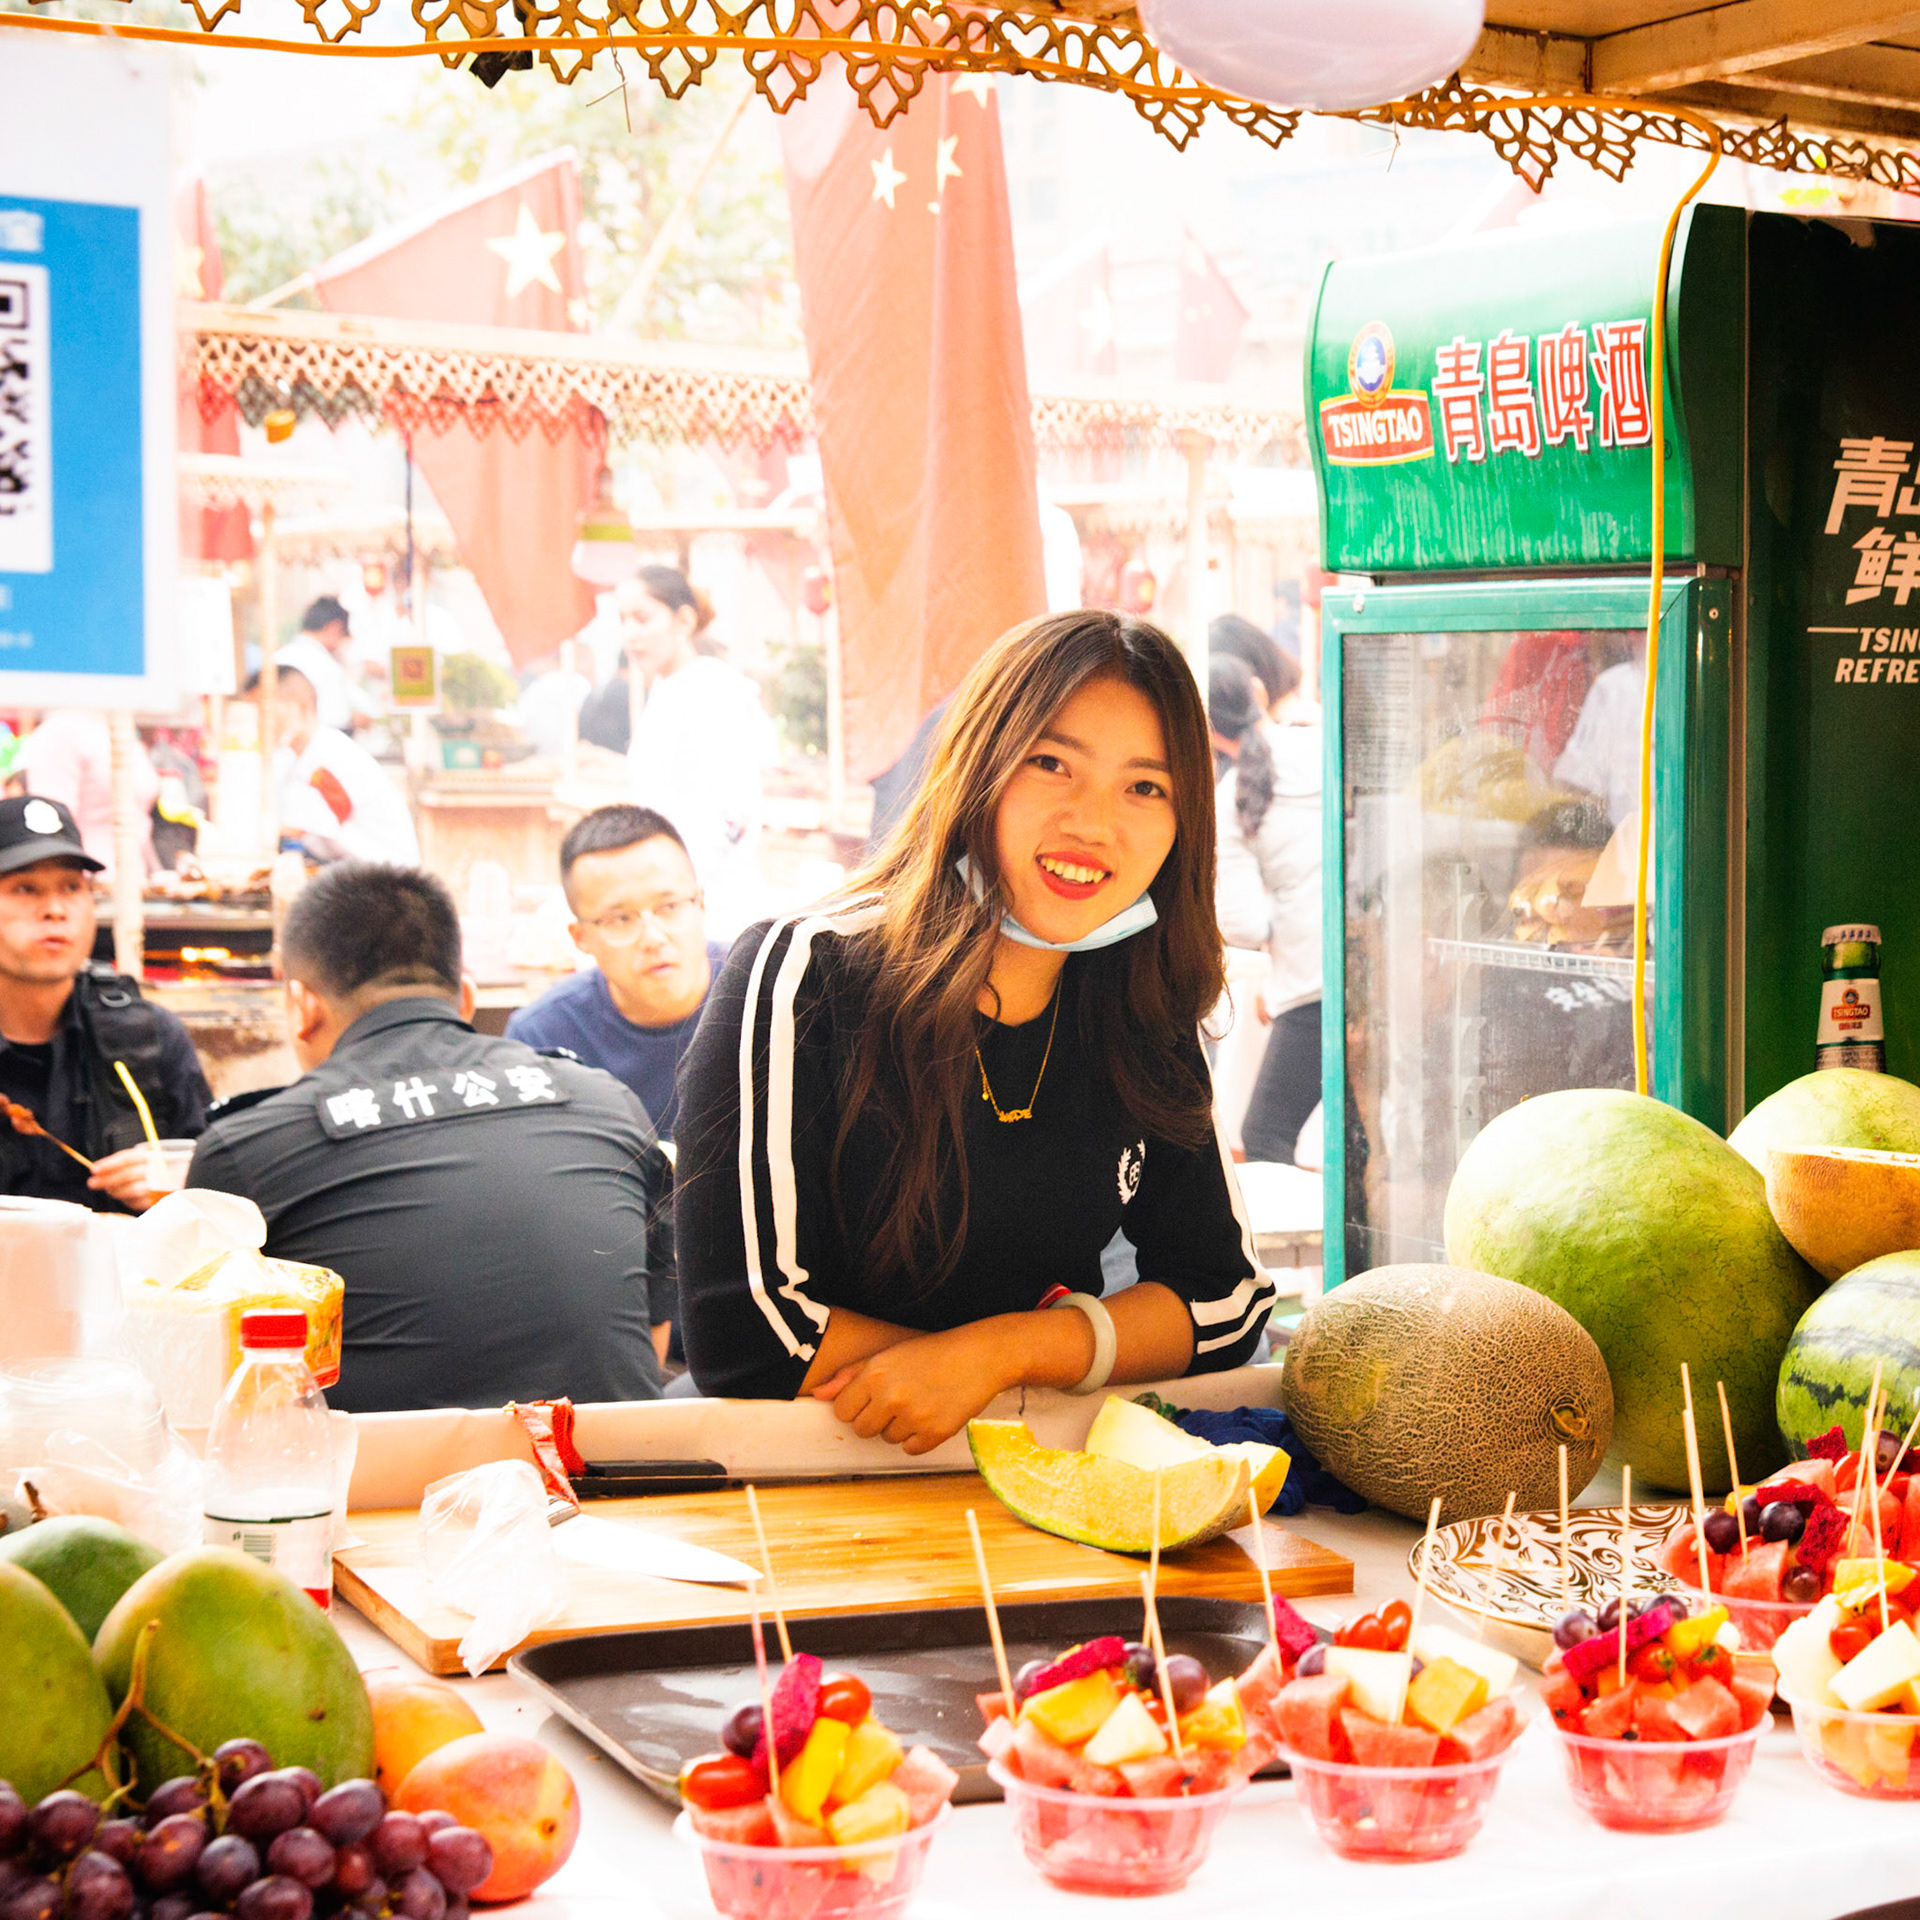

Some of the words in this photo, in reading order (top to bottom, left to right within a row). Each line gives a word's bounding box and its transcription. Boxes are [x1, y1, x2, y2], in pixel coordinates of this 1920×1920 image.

[1431, 318, 1653, 462] 青島啤酒
[1328, 407, 1423, 448] TSINGTAO
[1824, 436, 1920, 535] 青
[1859, 627, 1920, 653] TSIN
[1833, 1007, 1869, 1018] TSINGTAO
